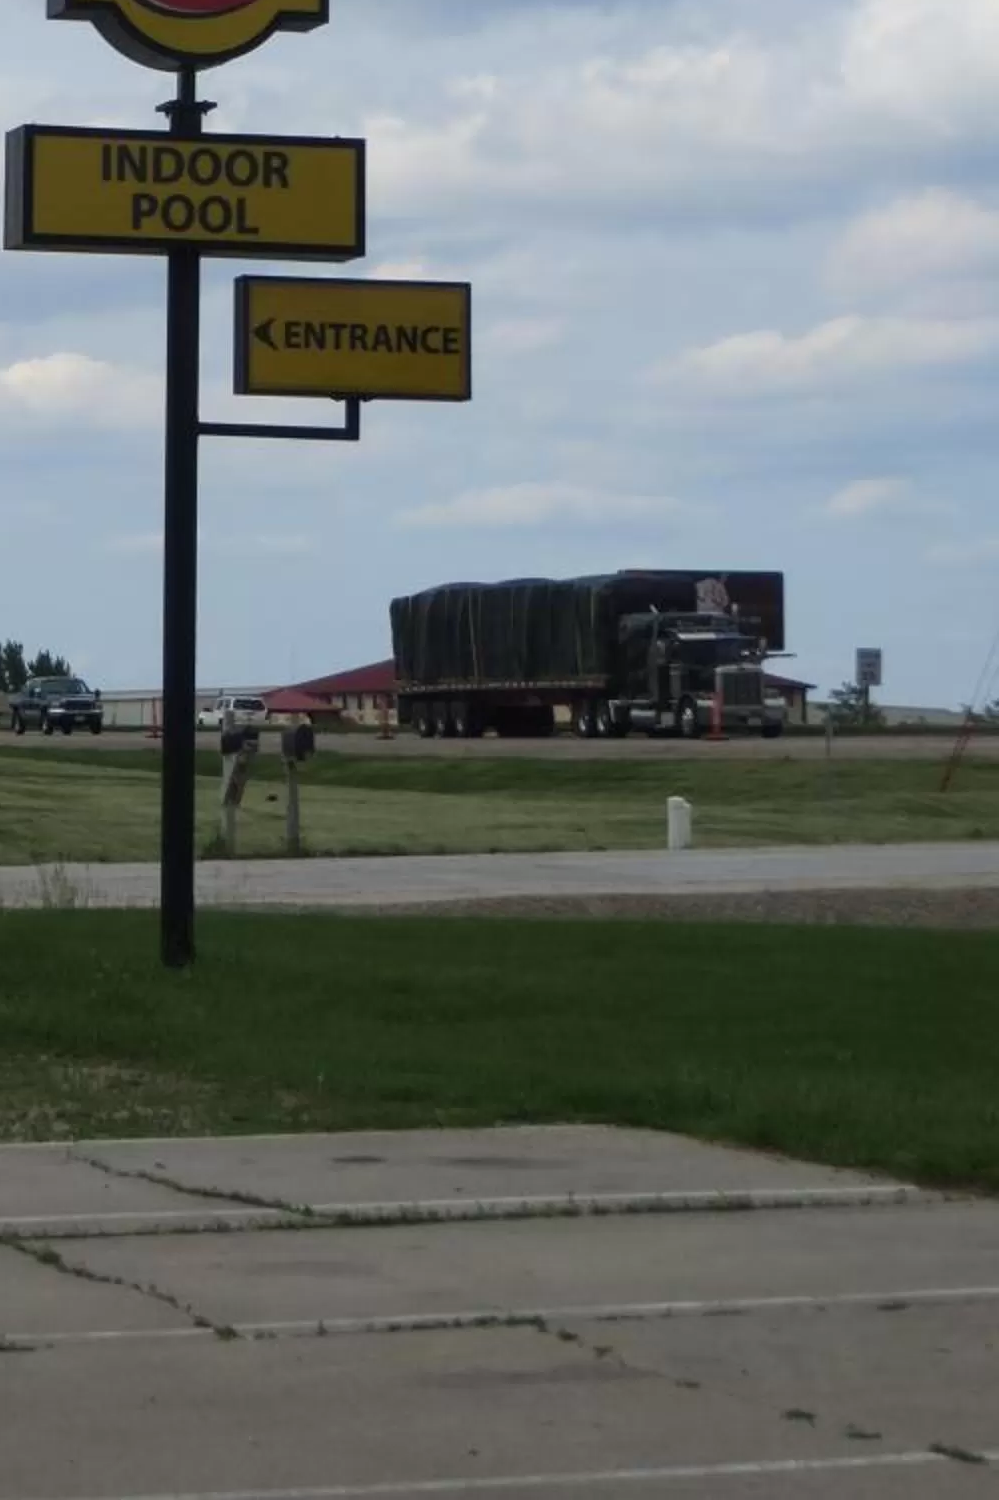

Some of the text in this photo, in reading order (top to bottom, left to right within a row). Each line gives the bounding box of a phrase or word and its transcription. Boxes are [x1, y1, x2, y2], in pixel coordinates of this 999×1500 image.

[101, 143, 290, 189] INDOOR
[131, 193, 260, 236] POOL
[284, 321, 460, 355] ENTRANCE
